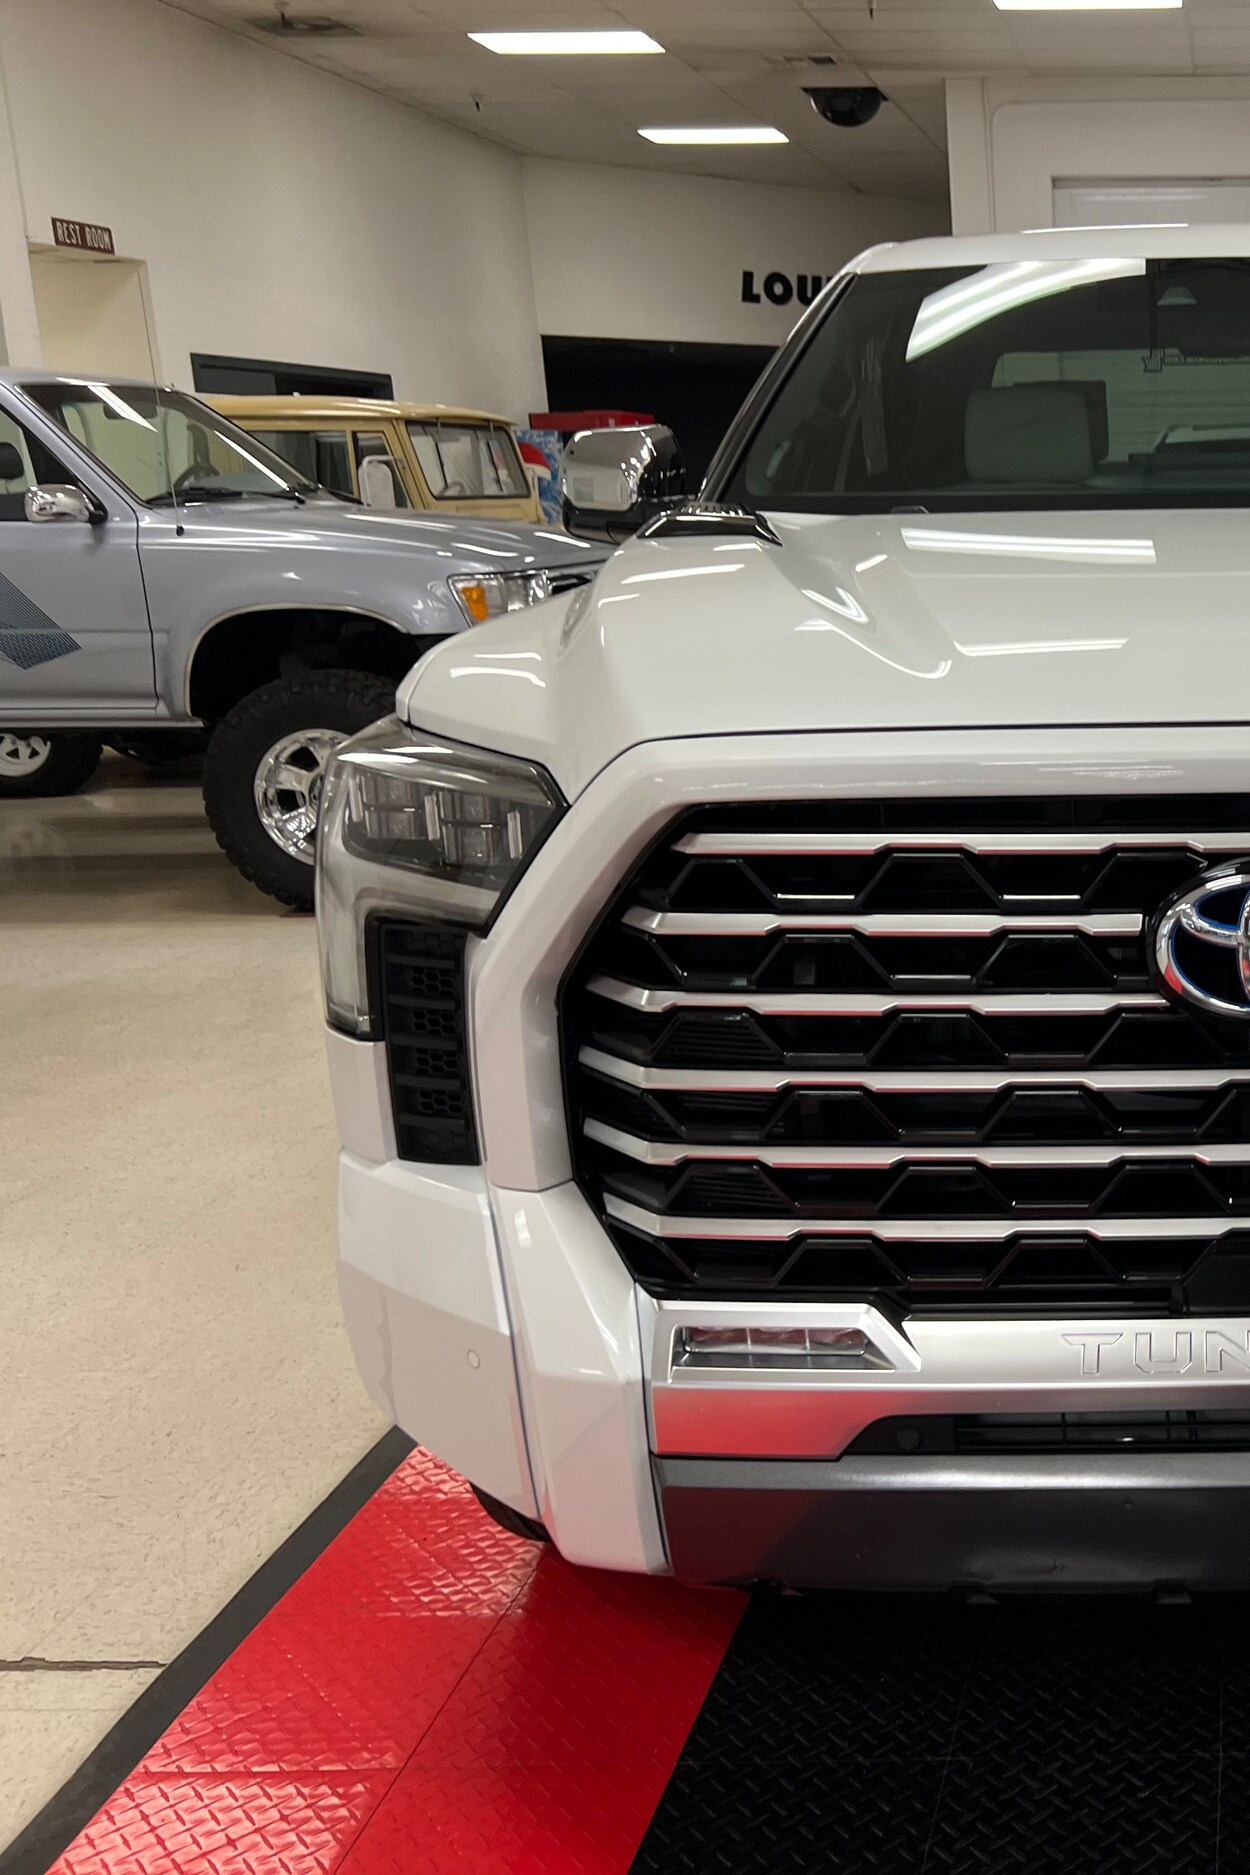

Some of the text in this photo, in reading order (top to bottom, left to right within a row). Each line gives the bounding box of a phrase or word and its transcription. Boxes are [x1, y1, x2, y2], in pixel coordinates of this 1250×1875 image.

[55, 220, 112, 251] REST ROOM
[741, 270, 834, 307] LOU
